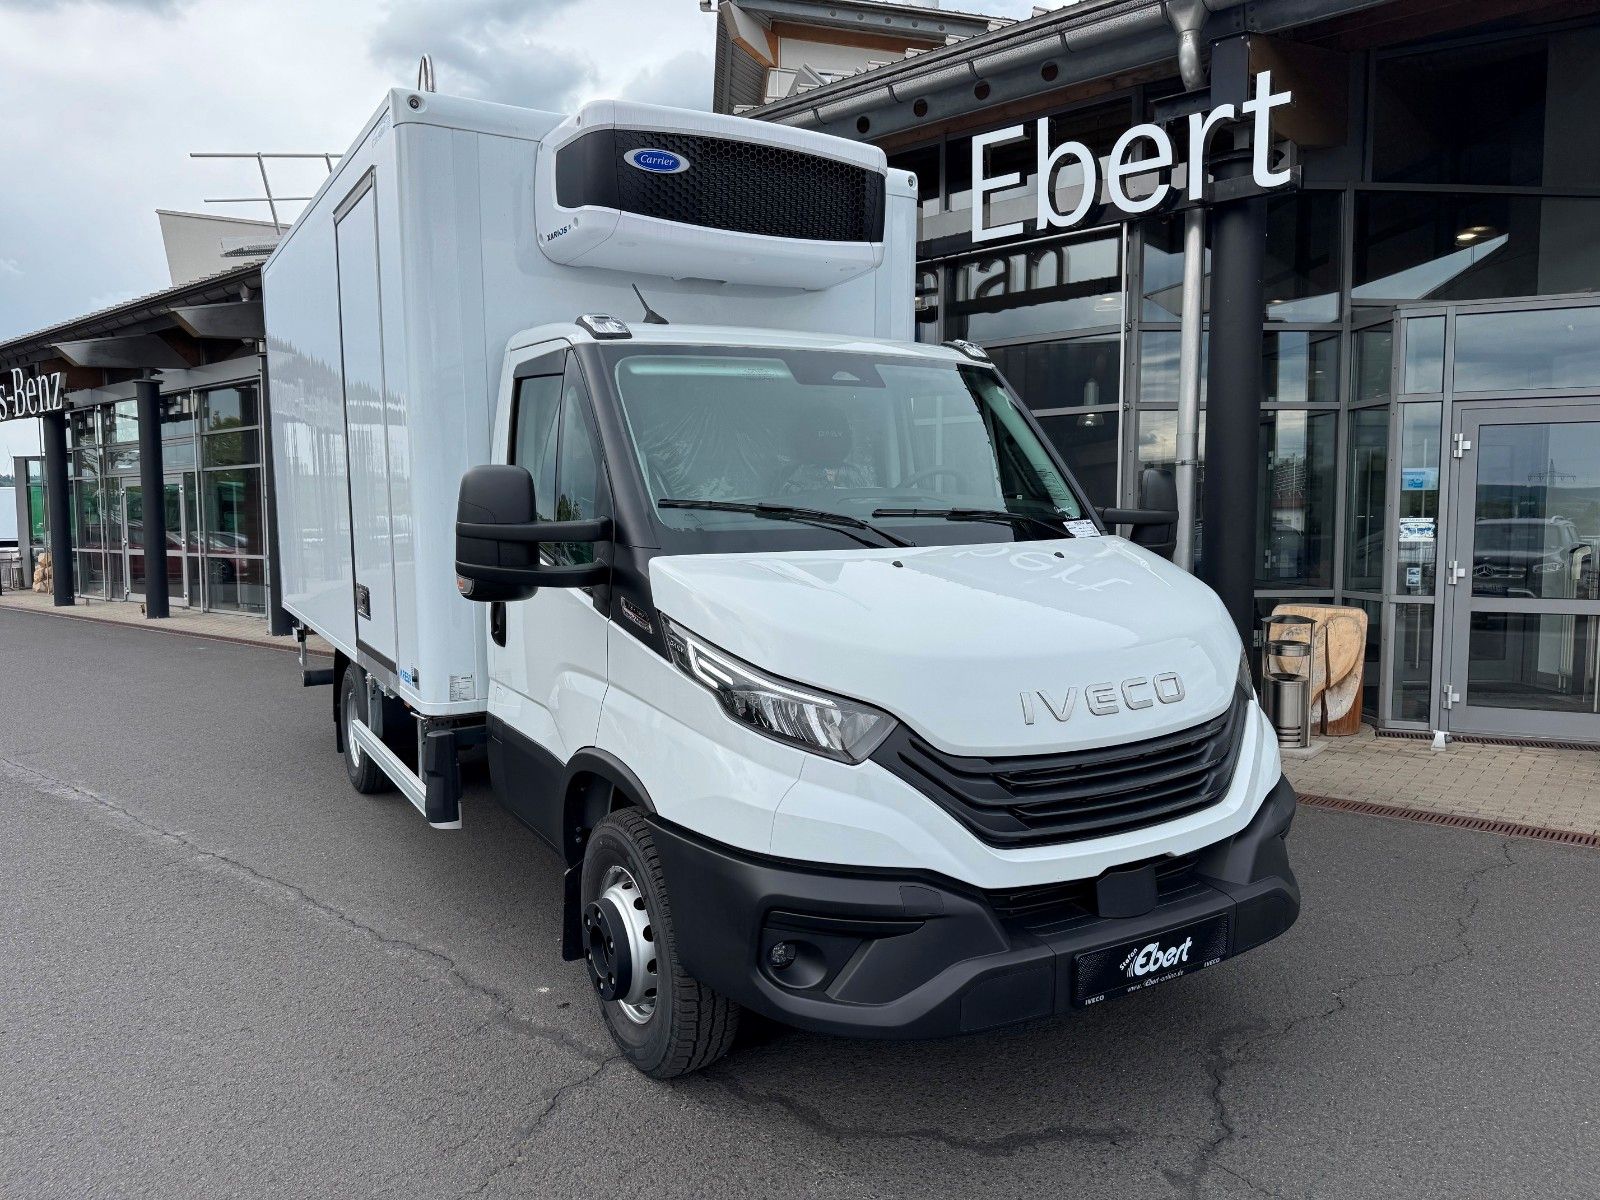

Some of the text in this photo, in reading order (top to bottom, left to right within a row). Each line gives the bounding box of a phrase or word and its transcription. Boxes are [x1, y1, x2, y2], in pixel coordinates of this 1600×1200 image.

[640, 154, 675, 166] Carrier
[972, 70, 1292, 243] Ebert
[1019, 671, 1186, 726] IVECO
[1119, 936, 1193, 976] Stefan Ebert
[1203, 957, 1221, 968] IVECO
[1084, 994, 1105, 1006] IVECO
